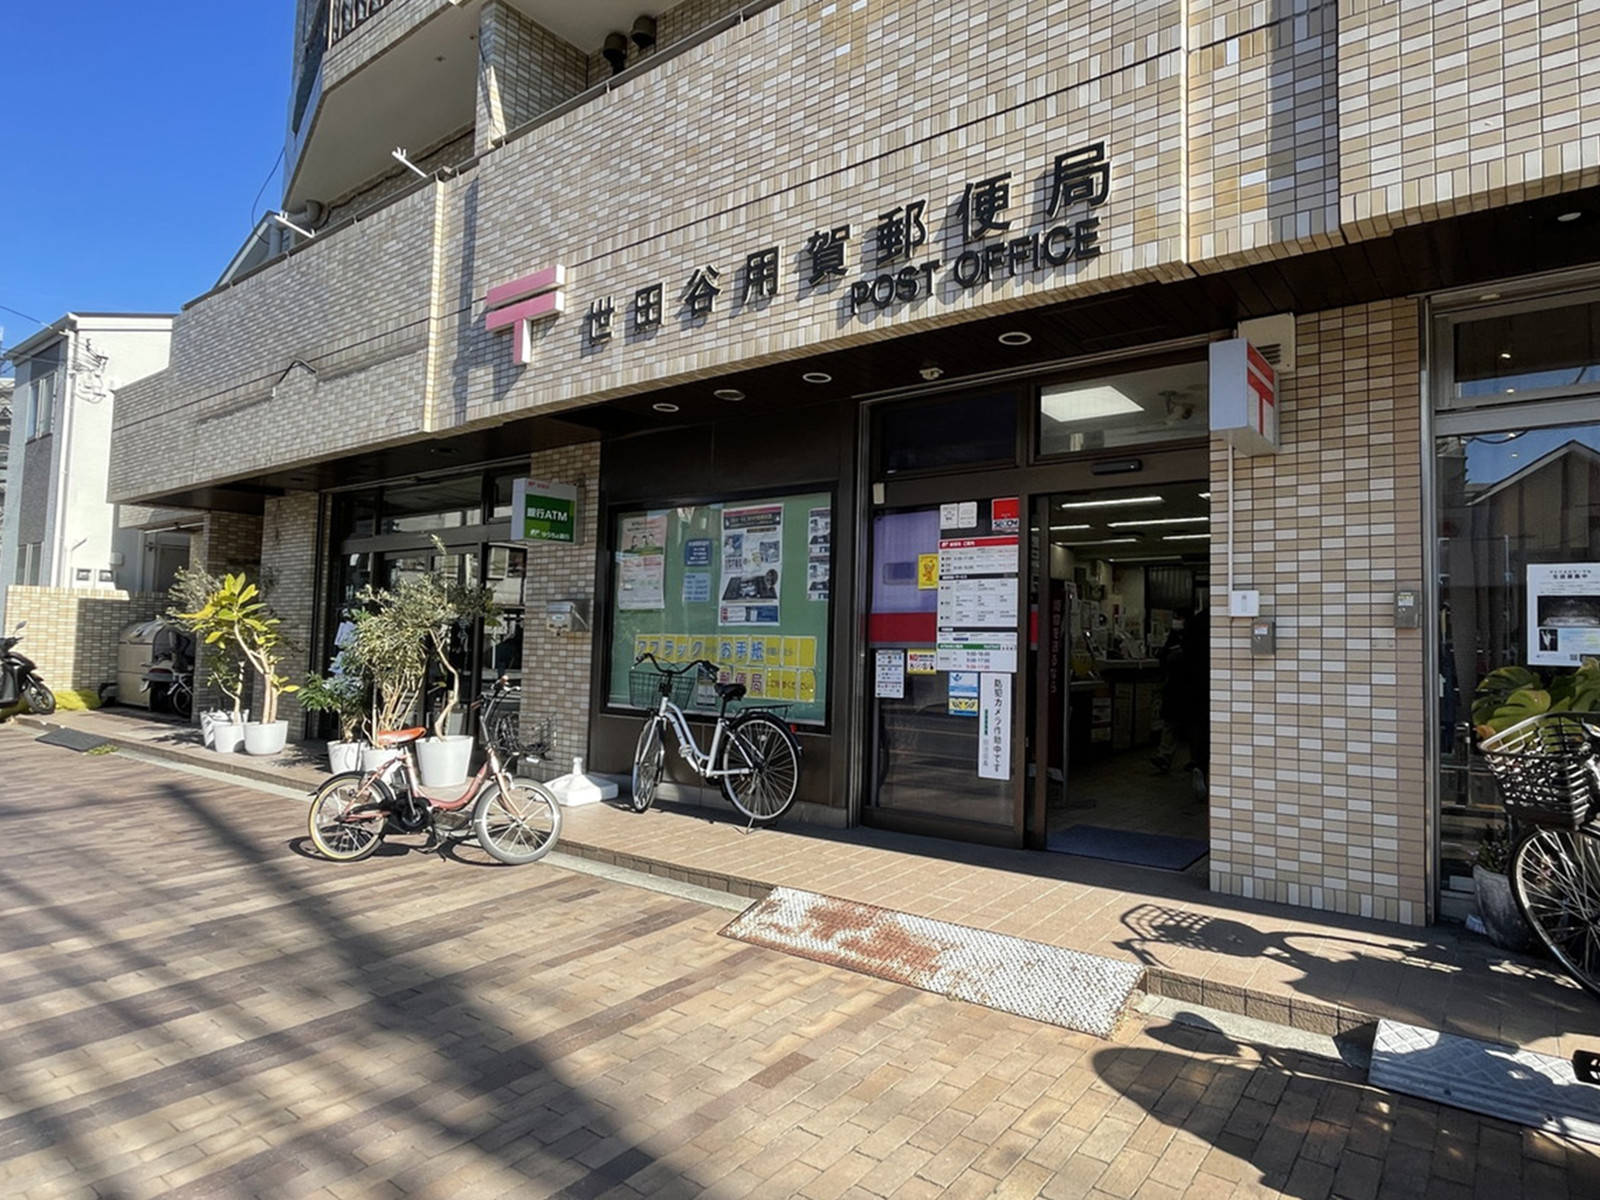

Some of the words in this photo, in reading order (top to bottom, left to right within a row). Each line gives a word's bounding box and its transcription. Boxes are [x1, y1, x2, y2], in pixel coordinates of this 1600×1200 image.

[586, 141, 1110, 345] 世田谷用賀郵便局
[850, 259, 940, 315] POST
[953, 217, 1102, 289] OFFICE
[526, 507, 568, 522] 銀行ATM
[721, 641, 764, 661] お手紙
